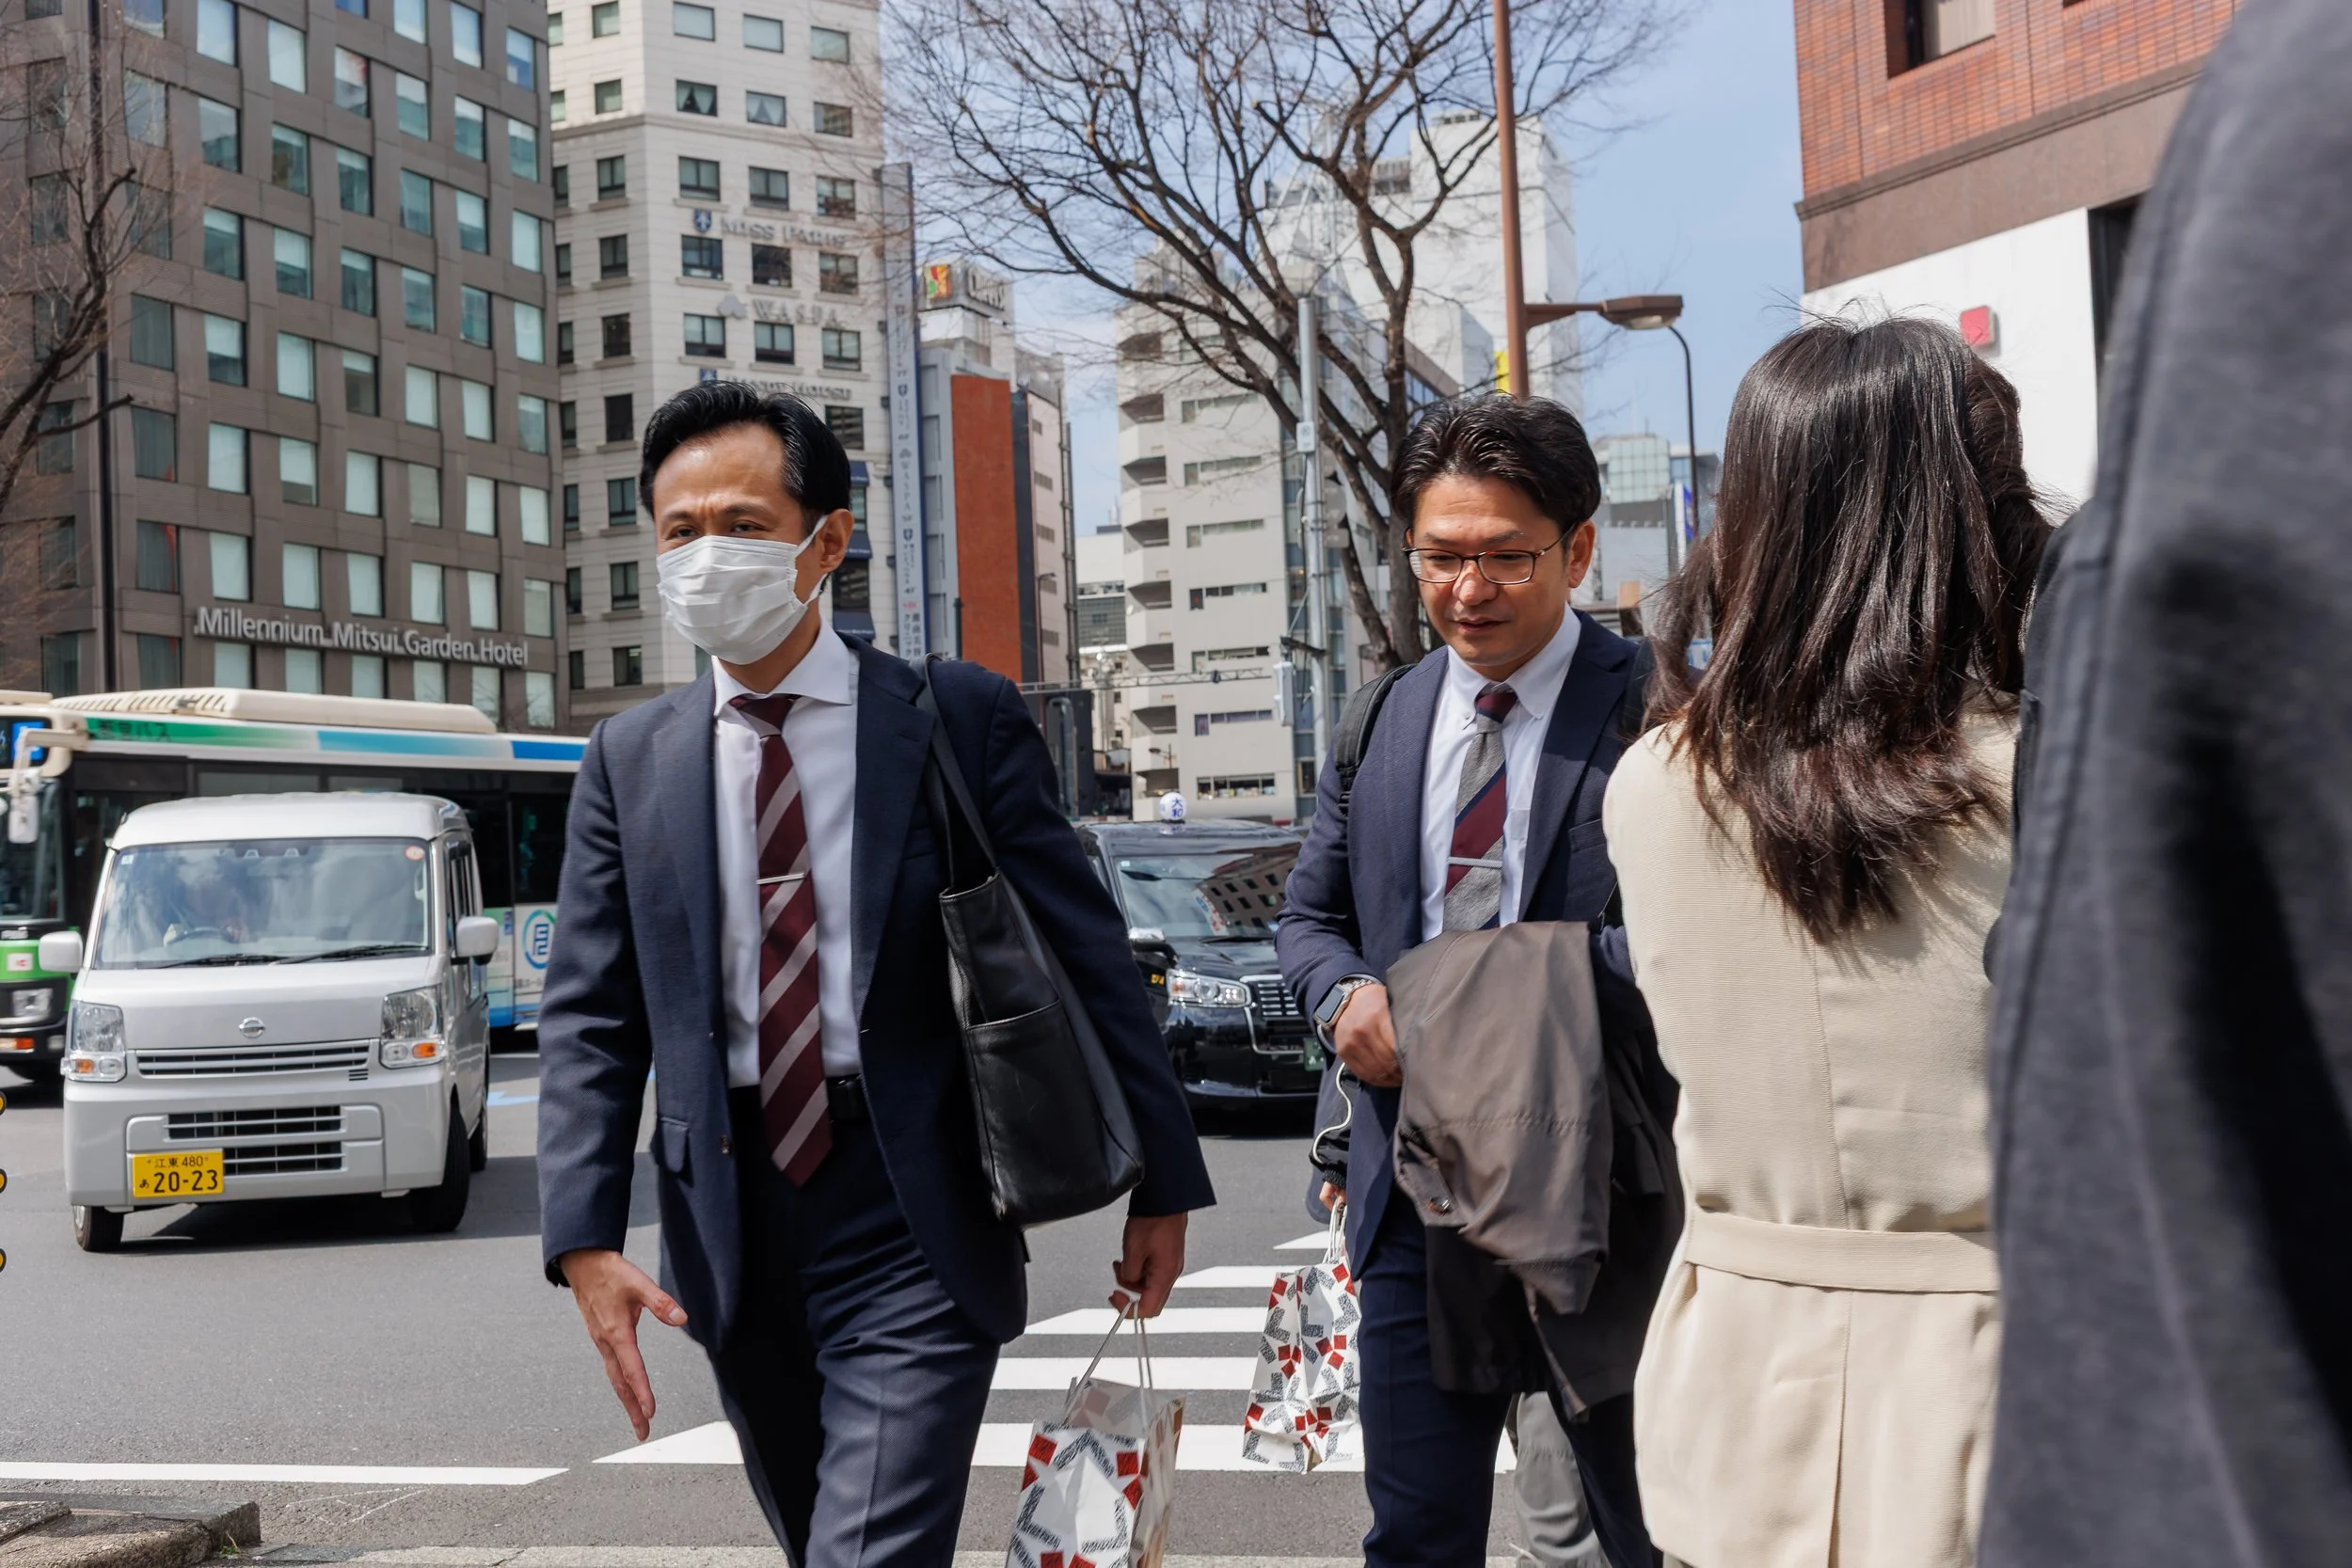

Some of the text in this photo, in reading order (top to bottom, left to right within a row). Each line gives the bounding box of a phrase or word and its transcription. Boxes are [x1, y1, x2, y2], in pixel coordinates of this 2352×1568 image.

[197, 607, 529, 666] Millennium Mitsui Garden Hotel
[1171, 798, 1184, 818] 大和
[154, 1155, 204, 1168] 江東 480
[138, 1169, 218, 1194] あ 20-23
